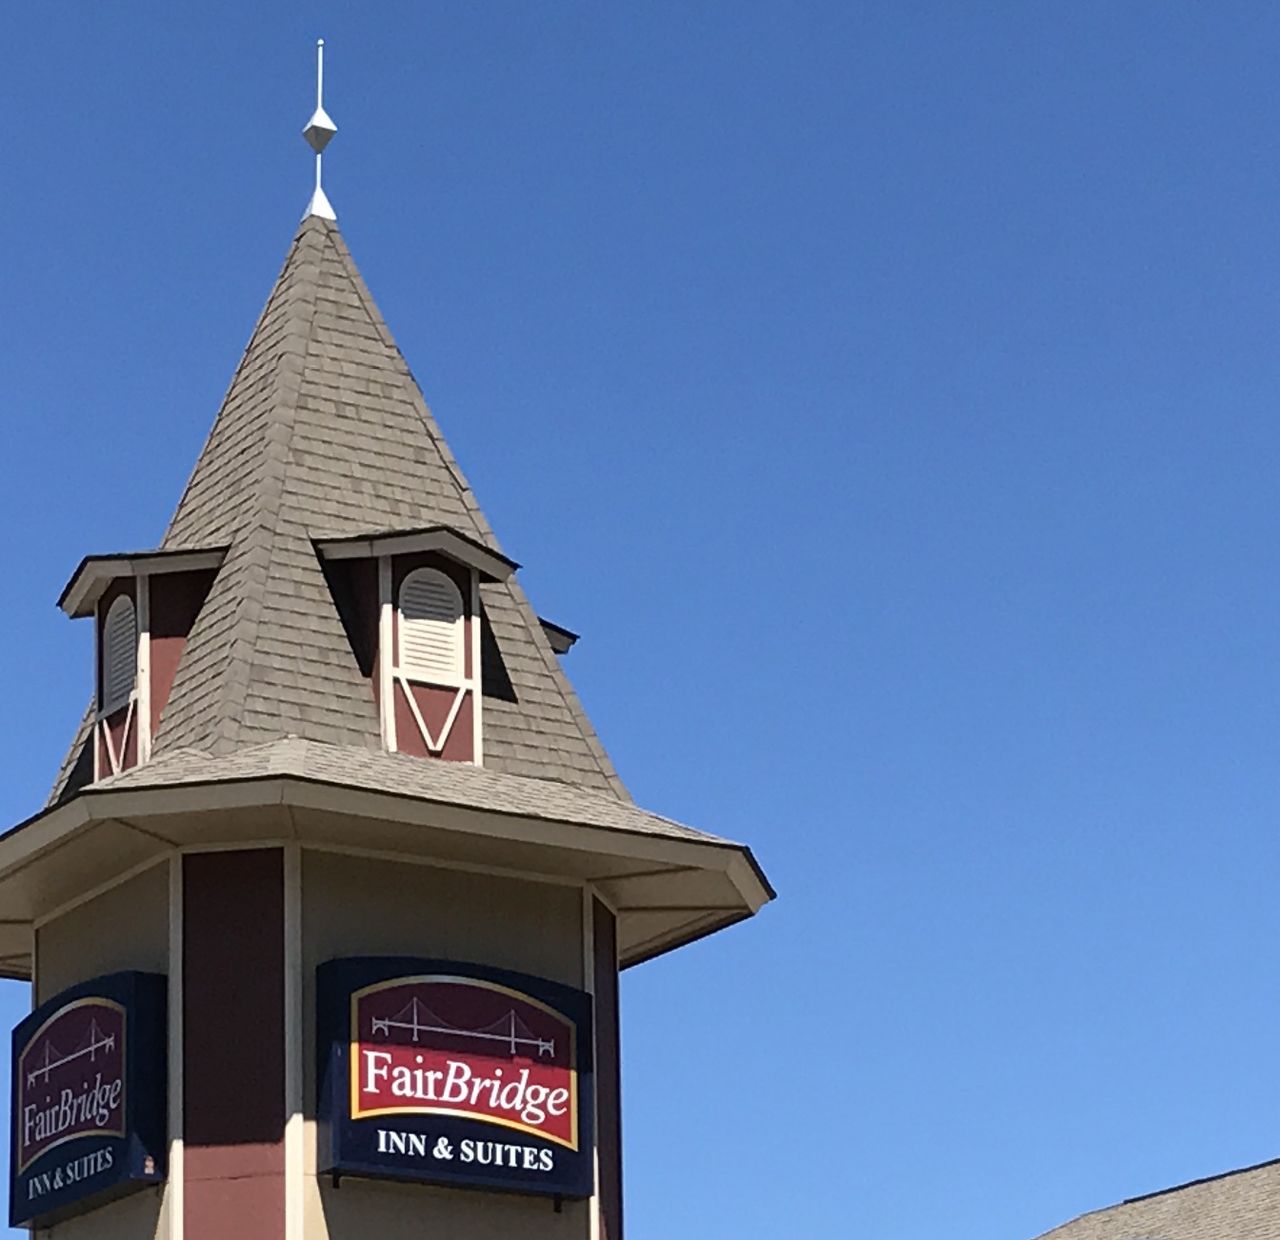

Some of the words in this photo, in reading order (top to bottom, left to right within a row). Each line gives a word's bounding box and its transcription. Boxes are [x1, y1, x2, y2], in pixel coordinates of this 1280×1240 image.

[24, 1072, 122, 1147] FairBridge
[363, 1050, 568, 1124] FairBridge
[28, 1170, 52, 1200] INN
[53, 1167, 64, 1190] &
[66, 1146, 113, 1185] SUITES
[377, 1129, 426, 1156] INN
[433, 1136, 454, 1160] &
[460, 1139, 554, 1172] SUITES
